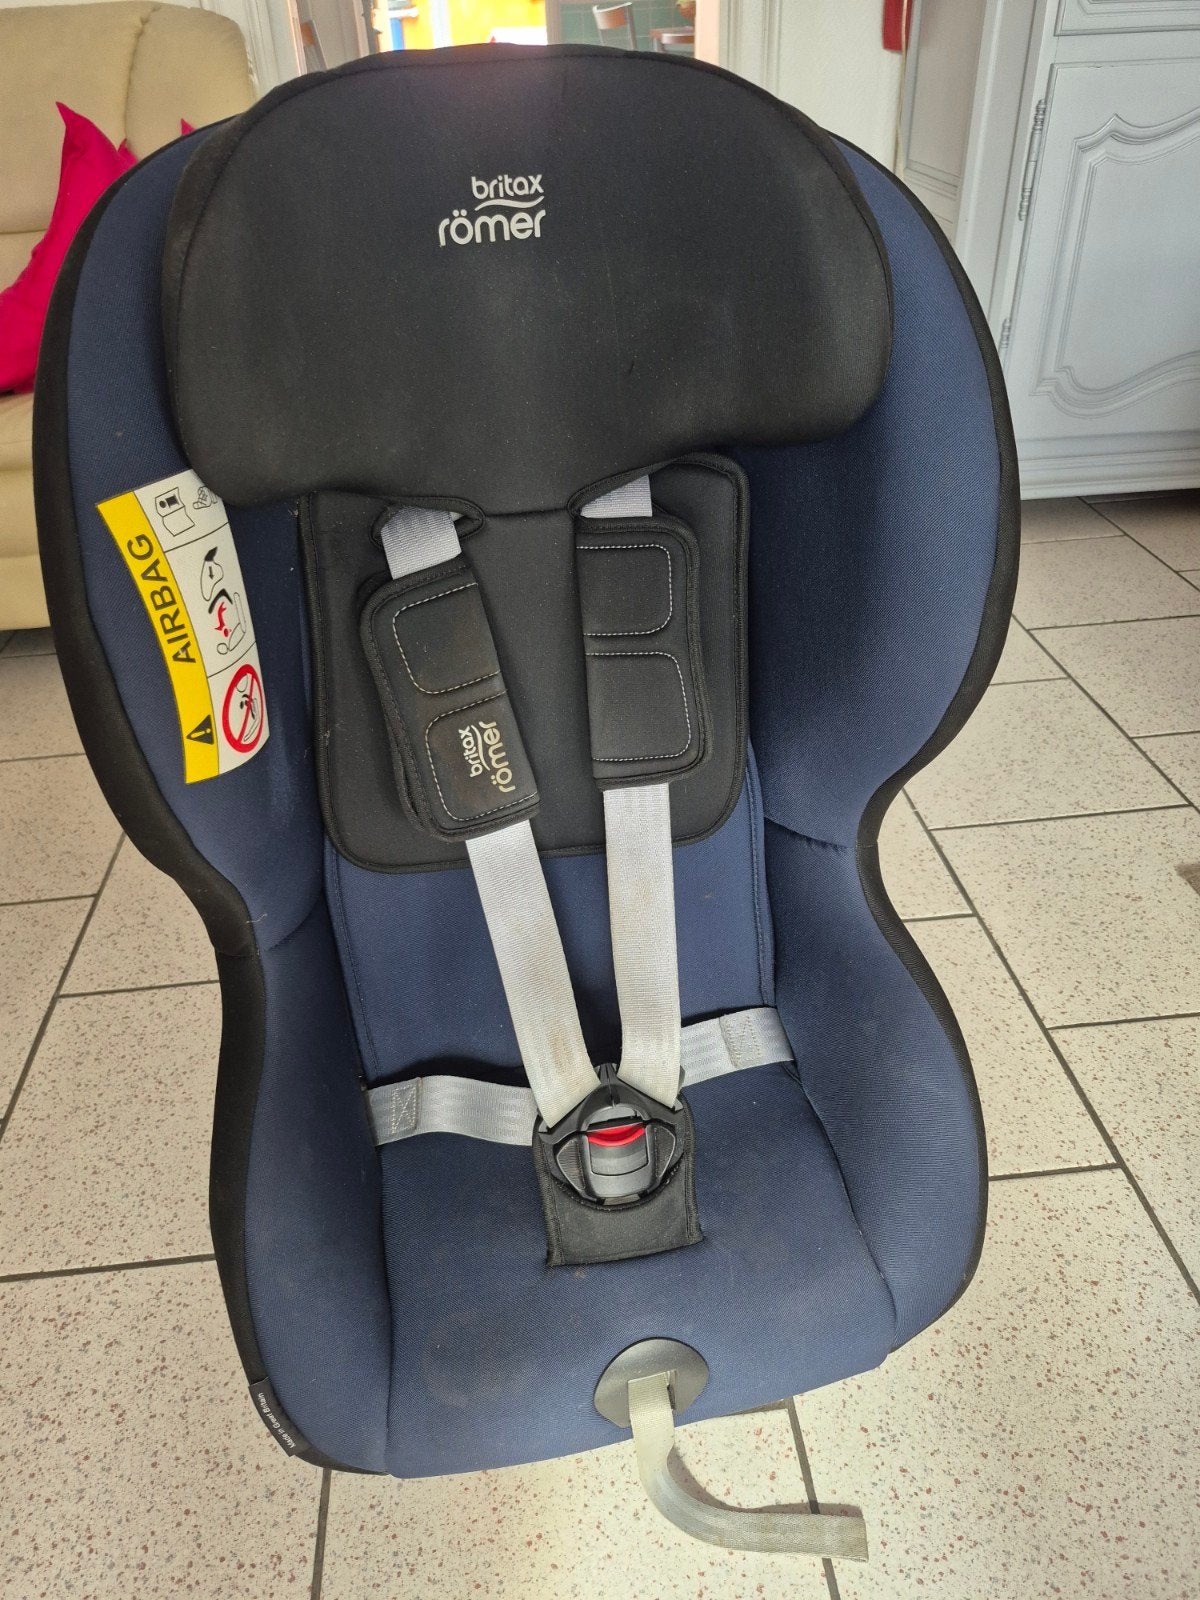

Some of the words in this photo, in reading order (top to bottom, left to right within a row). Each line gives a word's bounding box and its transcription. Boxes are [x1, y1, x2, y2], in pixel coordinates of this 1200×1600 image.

[471, 174, 544, 199] britax
[438, 209, 546, 246] römer
[126, 533, 197, 664] AIRBAG
[458, 725, 483, 778] britax
[478, 721, 516, 792] römer
[258, 1392, 271, 1413] Britain
[266, 1413, 281, 1429] Great
[282, 1433, 296, 1448] Made
